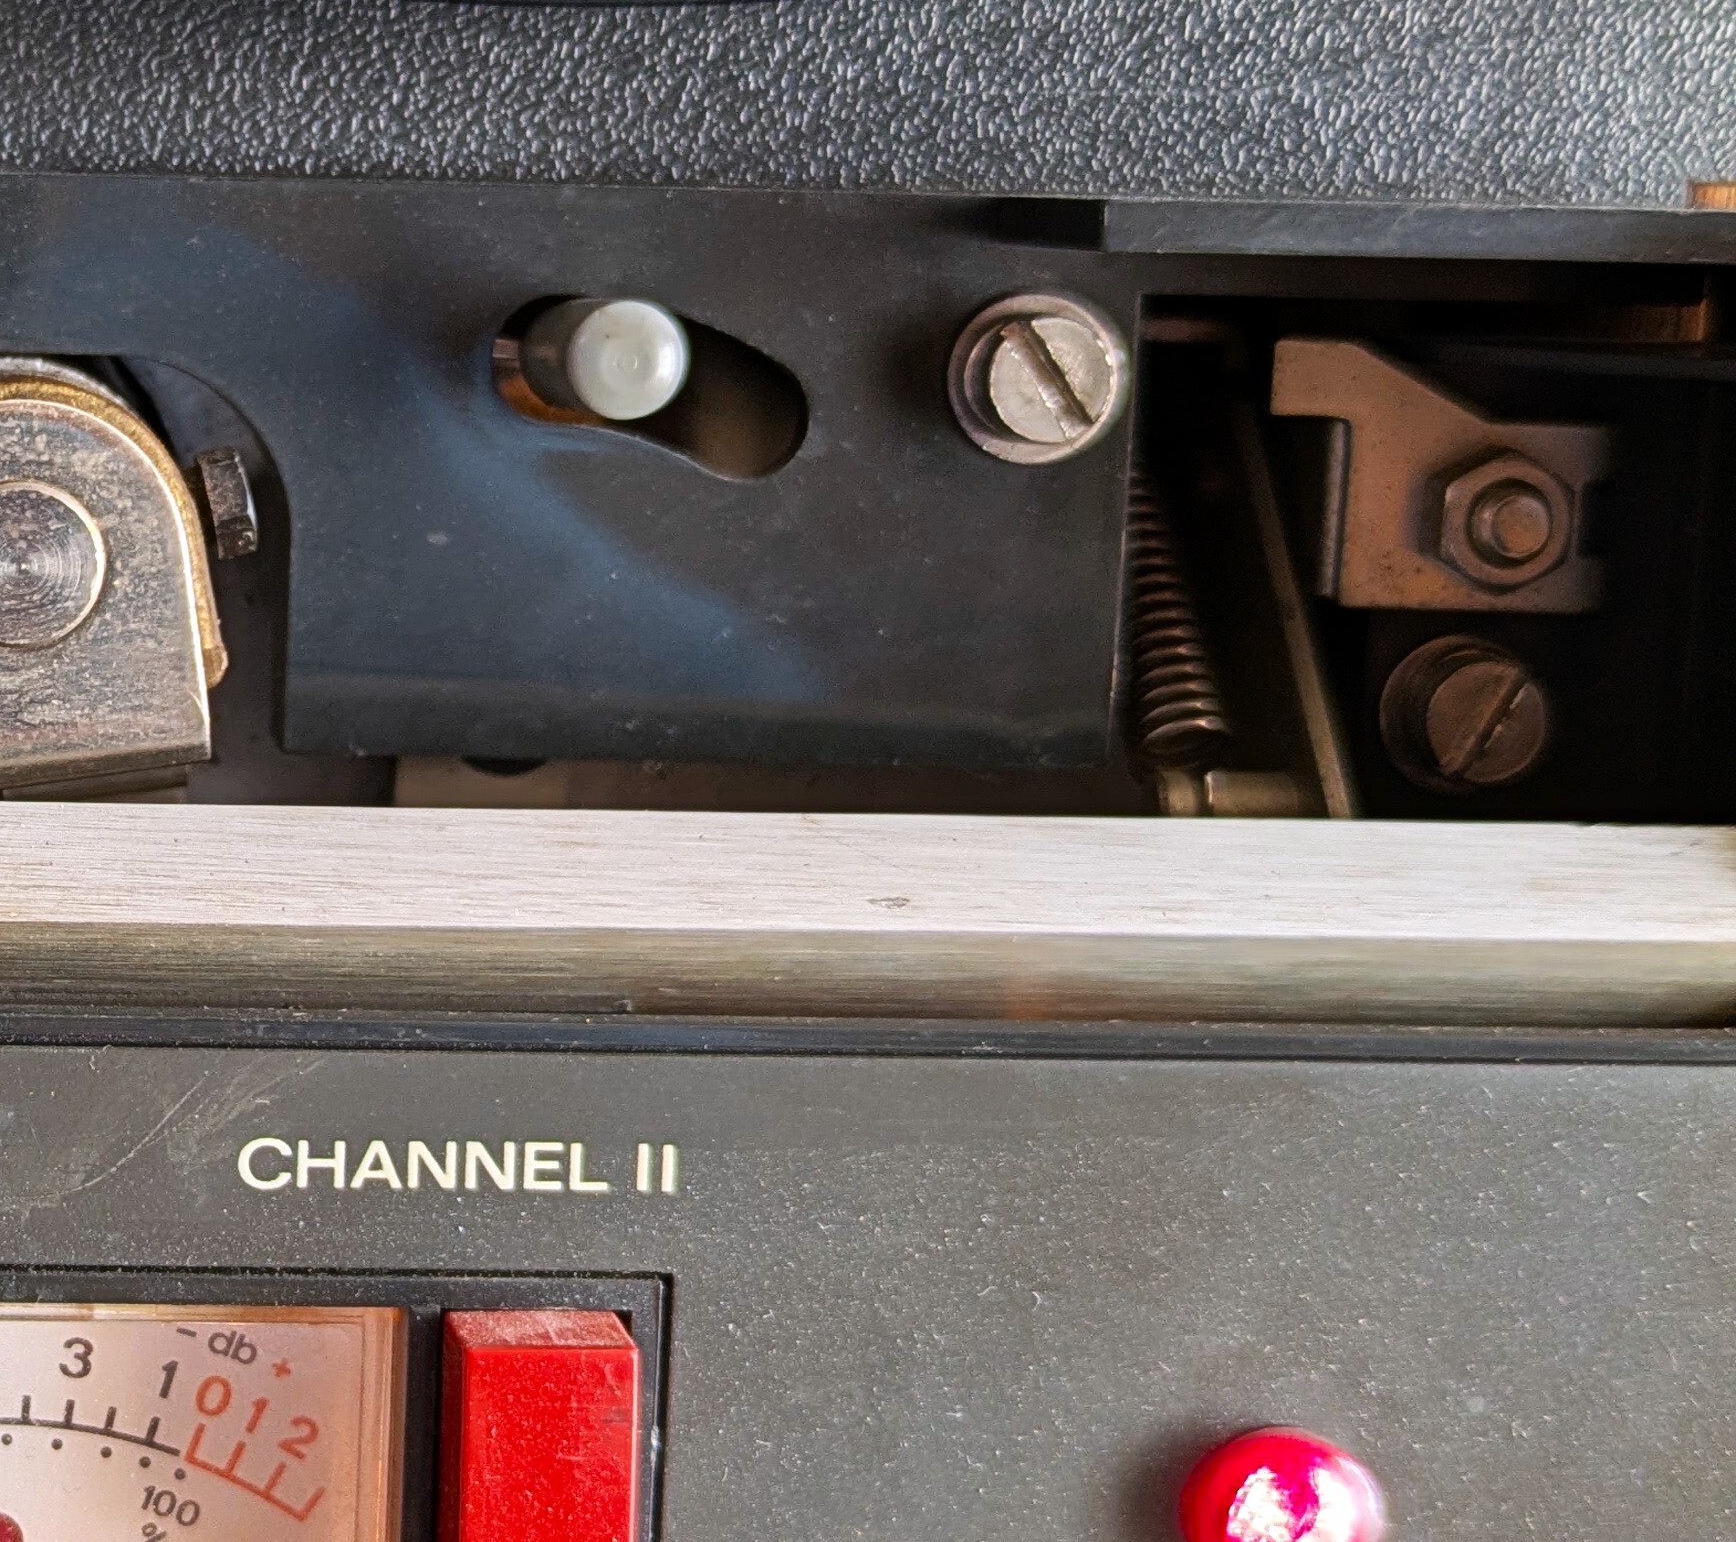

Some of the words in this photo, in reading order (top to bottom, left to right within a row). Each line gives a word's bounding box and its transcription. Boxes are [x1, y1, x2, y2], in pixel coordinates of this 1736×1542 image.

[238, 1137, 610, 1194] CHANNEL
[637, 1142, 677, 1195] II
[207, 1330, 258, 1366] db
[59, 1336, 94, 1379] 3
[158, 1360, 179, 1399] 1
[195, 1375, 233, 1417] 0
[244, 1396, 270, 1434] 1
[277, 1415, 320, 1460] 2
[140, 1485, 201, 1528] 100
